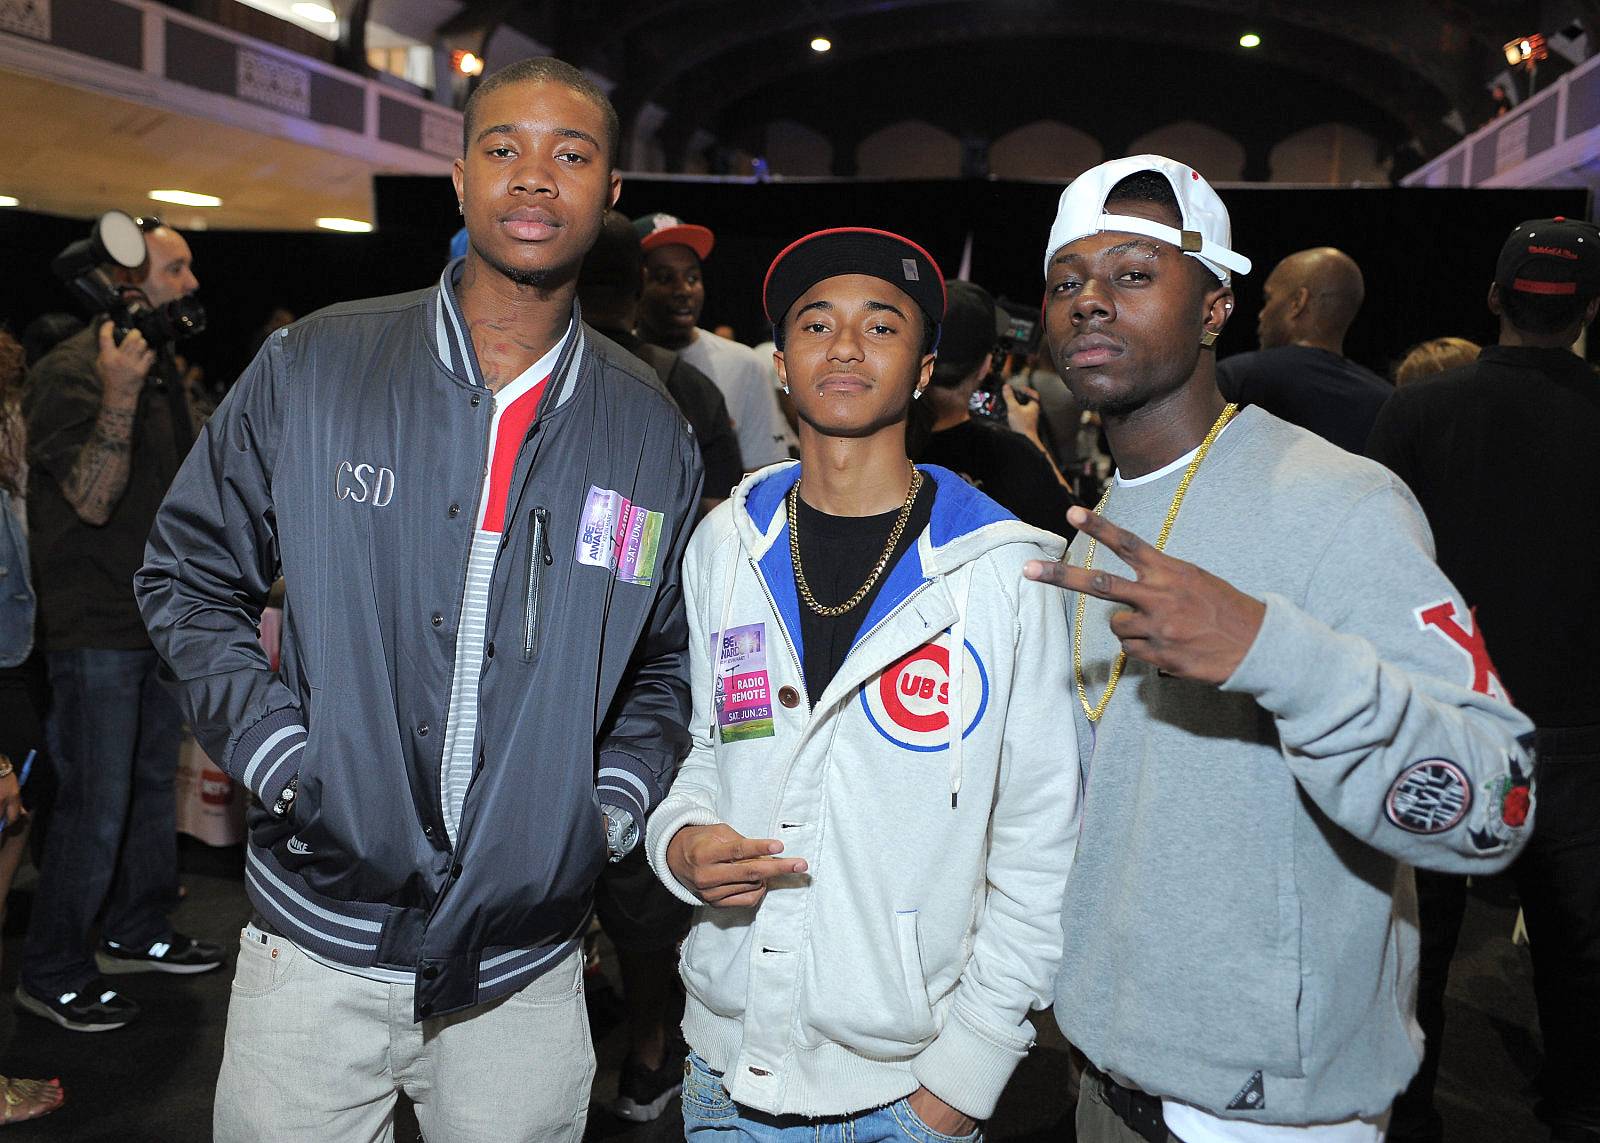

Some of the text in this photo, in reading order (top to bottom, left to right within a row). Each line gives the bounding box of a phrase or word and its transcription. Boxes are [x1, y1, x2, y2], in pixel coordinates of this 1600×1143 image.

[335, 461, 395, 506] CSD
[626, 543, 637, 564] SAT.
[737, 676, 765, 691] RADIO
[731, 689, 767, 704] REMOTE
[728, 707, 768, 722] SAT. JUN.25
[290, 835, 309, 851] NIKE
